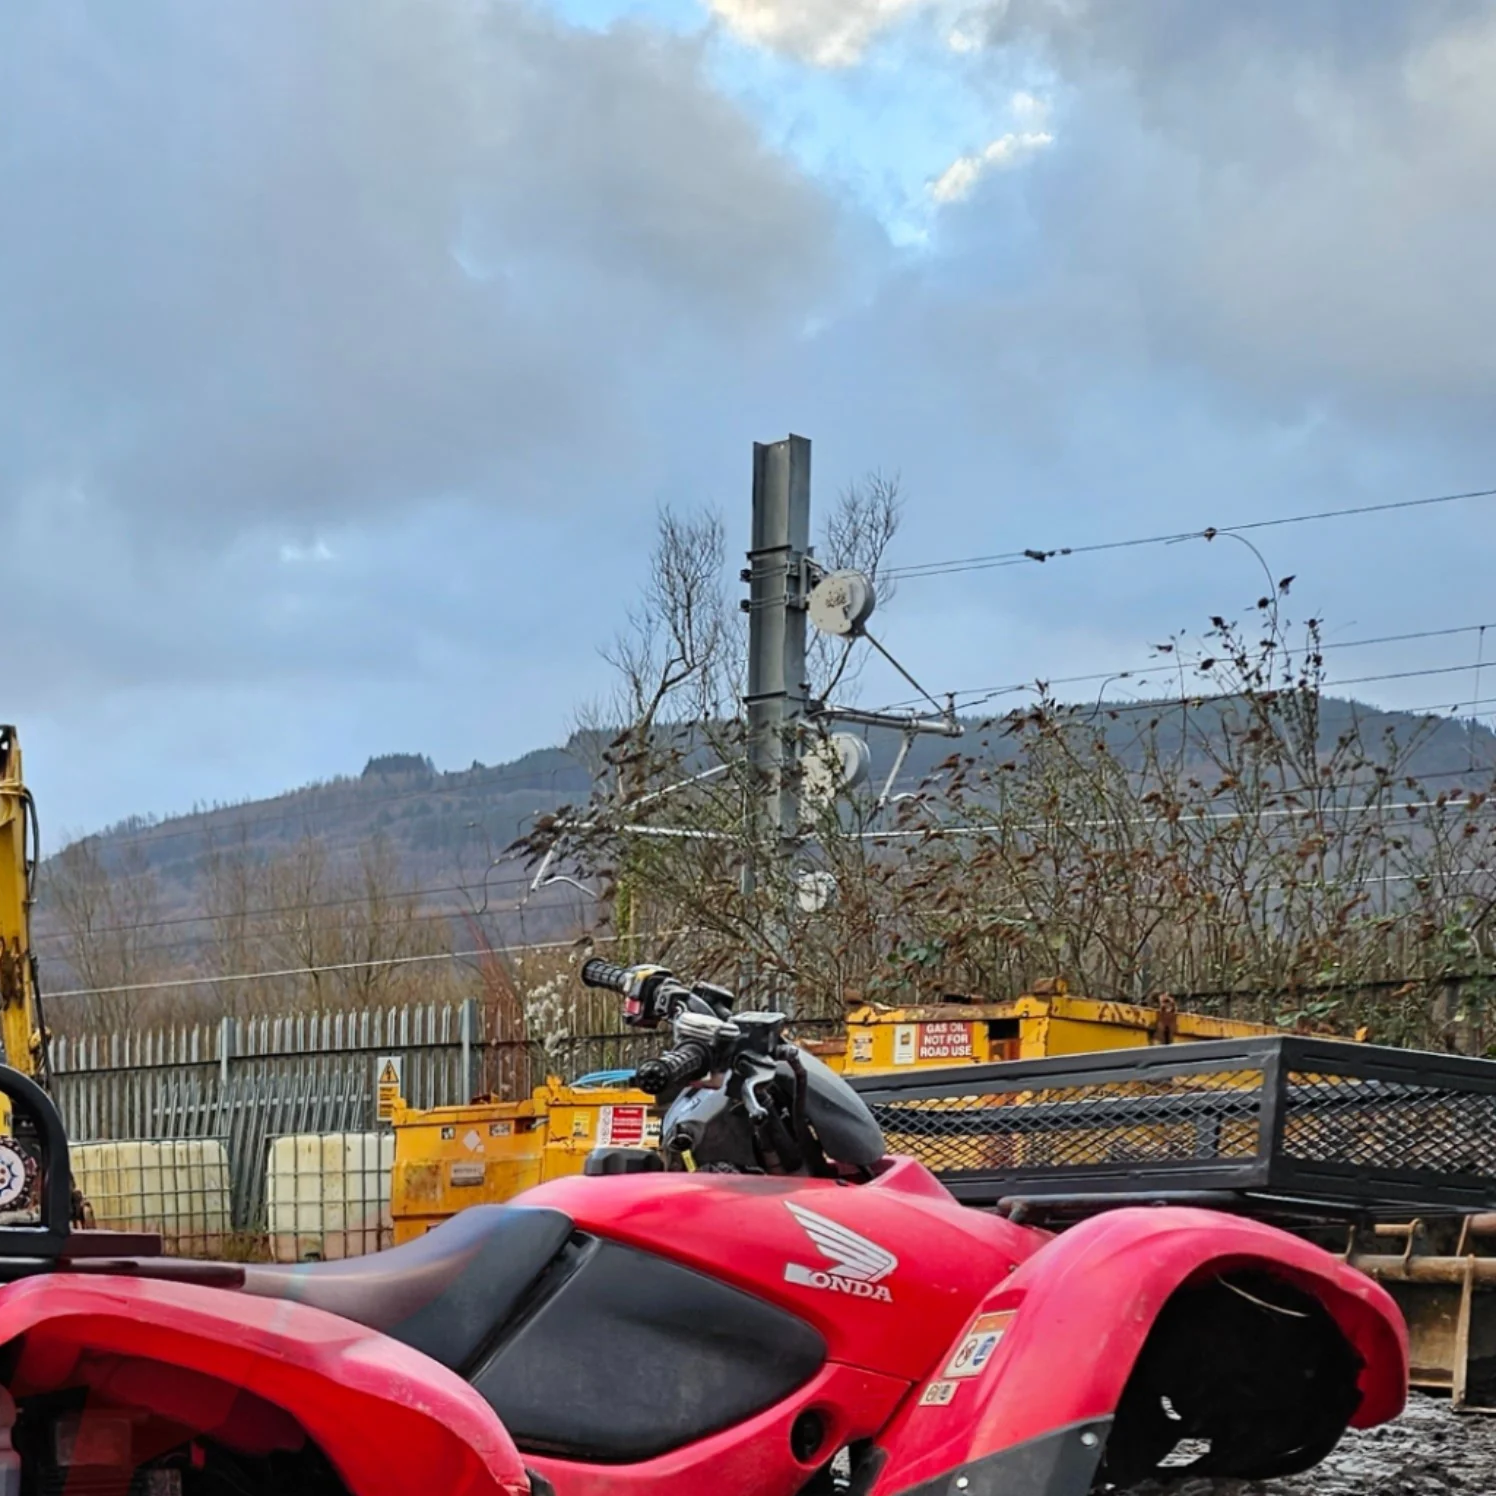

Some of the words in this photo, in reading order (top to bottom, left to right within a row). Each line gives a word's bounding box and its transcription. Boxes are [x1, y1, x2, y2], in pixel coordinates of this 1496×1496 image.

[926, 1023, 948, 1033] GAS
[950, 1022, 967, 1032] OIL
[924, 1034, 945, 1046] NOT
[947, 1033, 969, 1045] FOR
[920, 1046, 949, 1057] ROAD
[951, 1045, 972, 1057] USE
[786, 1263, 894, 1303] ONDA
